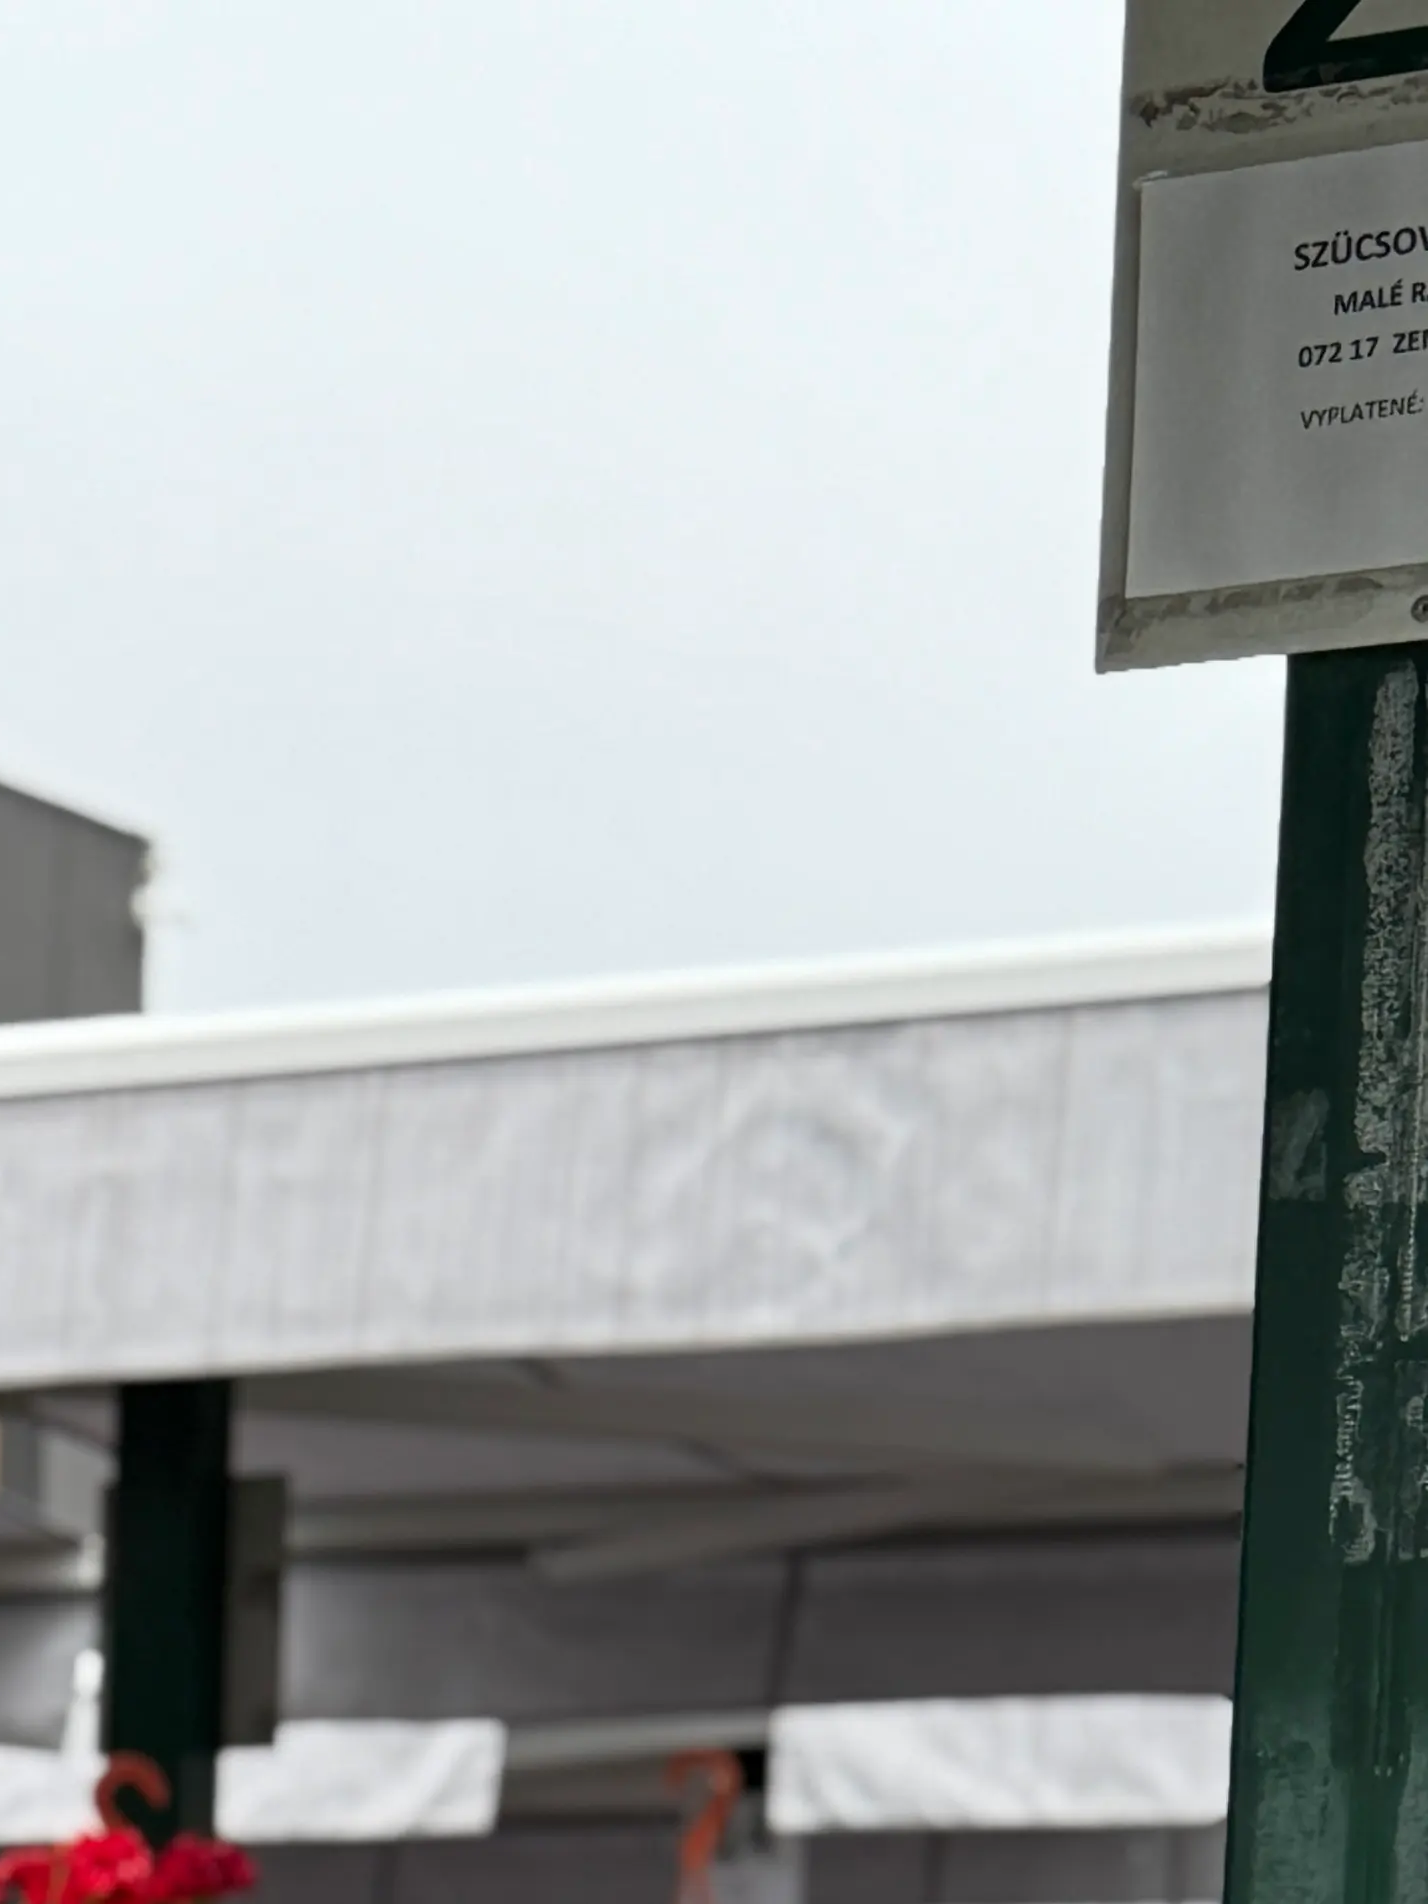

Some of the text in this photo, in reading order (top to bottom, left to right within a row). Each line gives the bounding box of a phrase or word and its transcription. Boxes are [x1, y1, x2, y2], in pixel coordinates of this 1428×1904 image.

[1334, 278, 1428, 316] MALÉ R
[1298, 342, 1342, 368] 072
[1349, 336, 1379, 361] 17
[1300, 389, 1424, 430] VYPLATENÉ:
